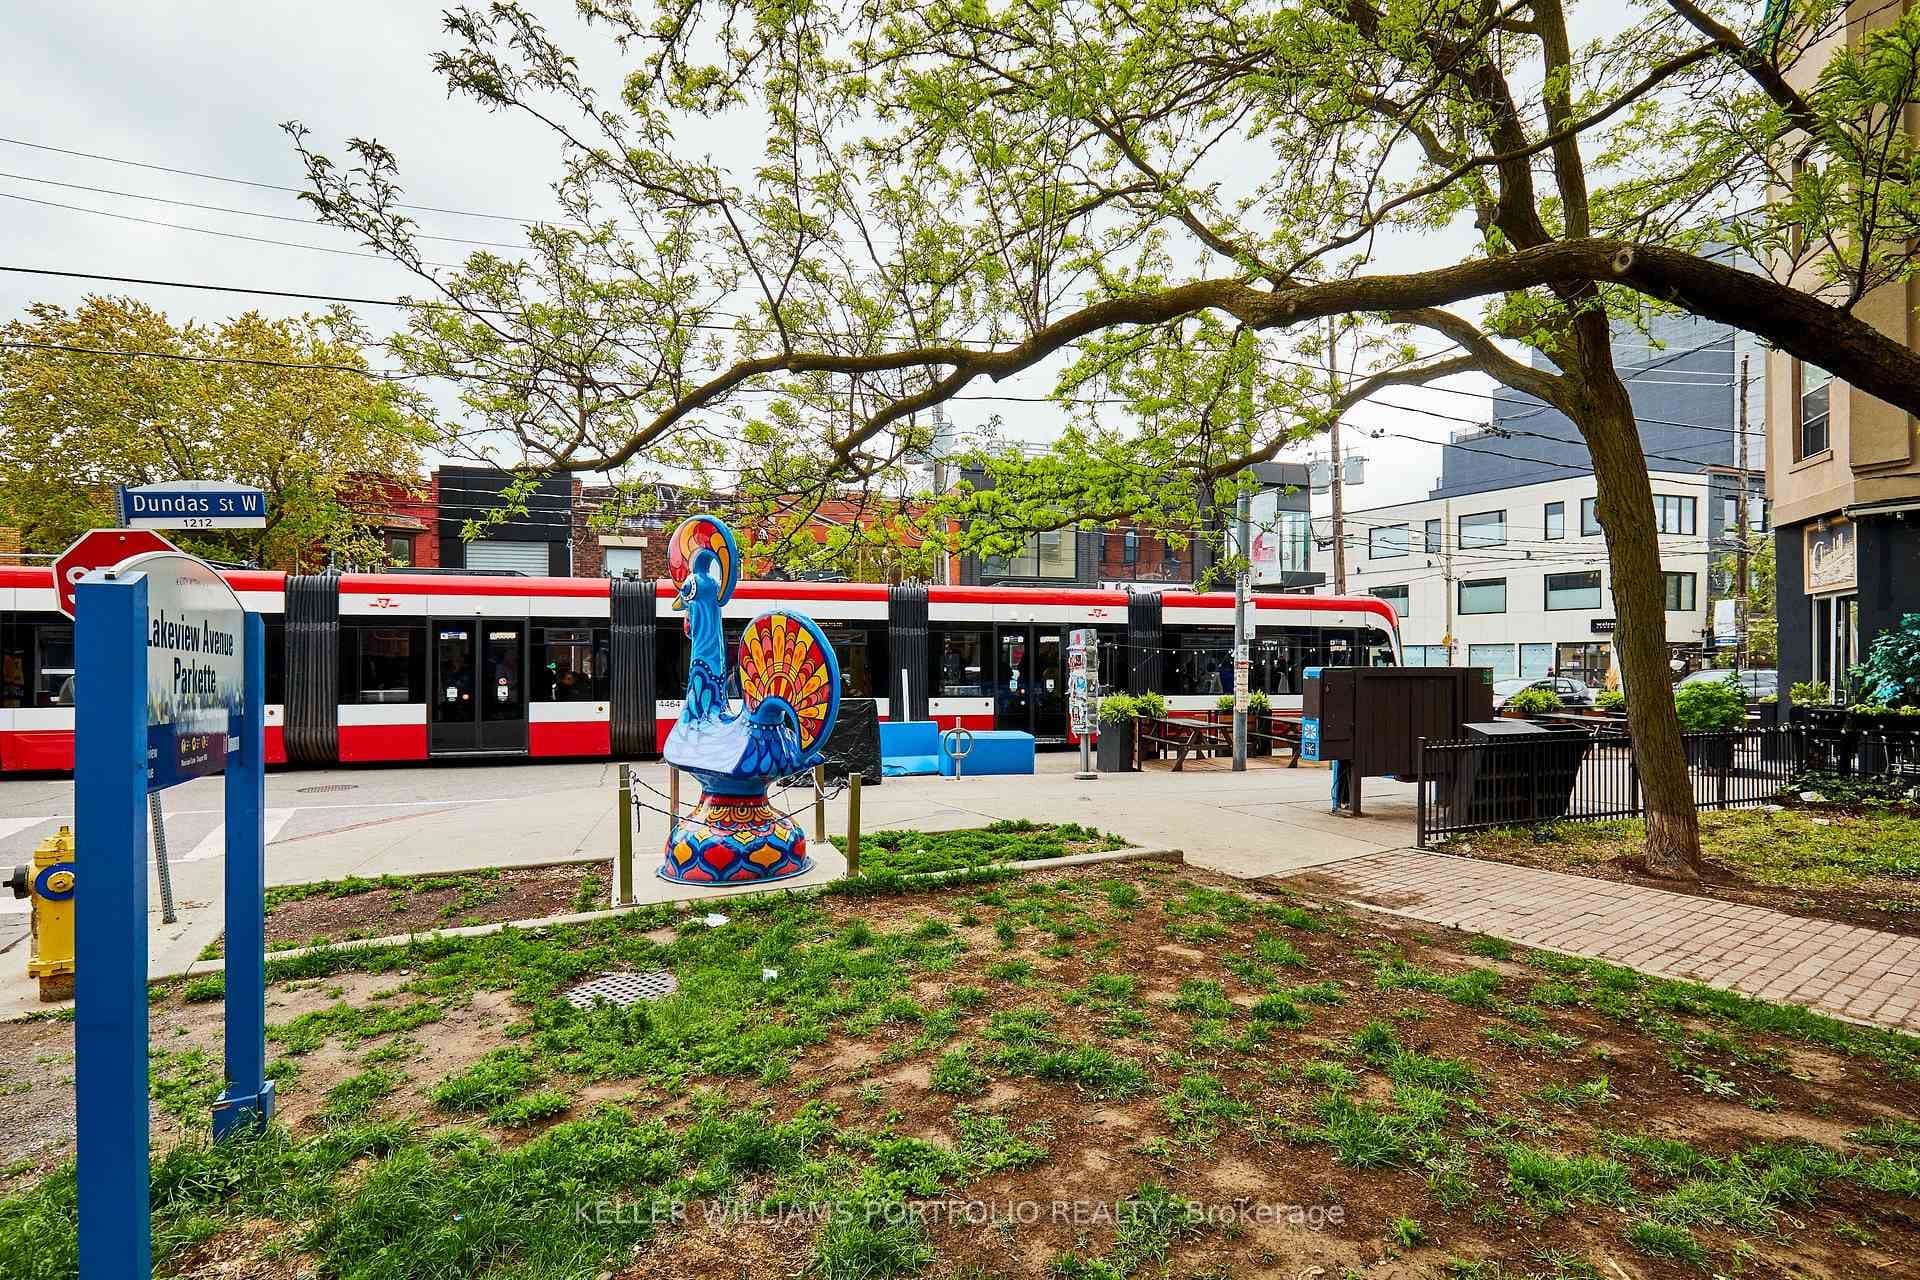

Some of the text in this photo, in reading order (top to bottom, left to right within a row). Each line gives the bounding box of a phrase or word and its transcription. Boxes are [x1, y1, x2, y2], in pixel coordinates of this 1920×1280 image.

[133, 495, 257, 512] Dundas St W
[183, 518, 213, 528] 1212
[147, 609, 234, 656] Lakeview Avenue
[173, 656, 216, 694] Parkette
[658, 700, 681, 708] 4464
